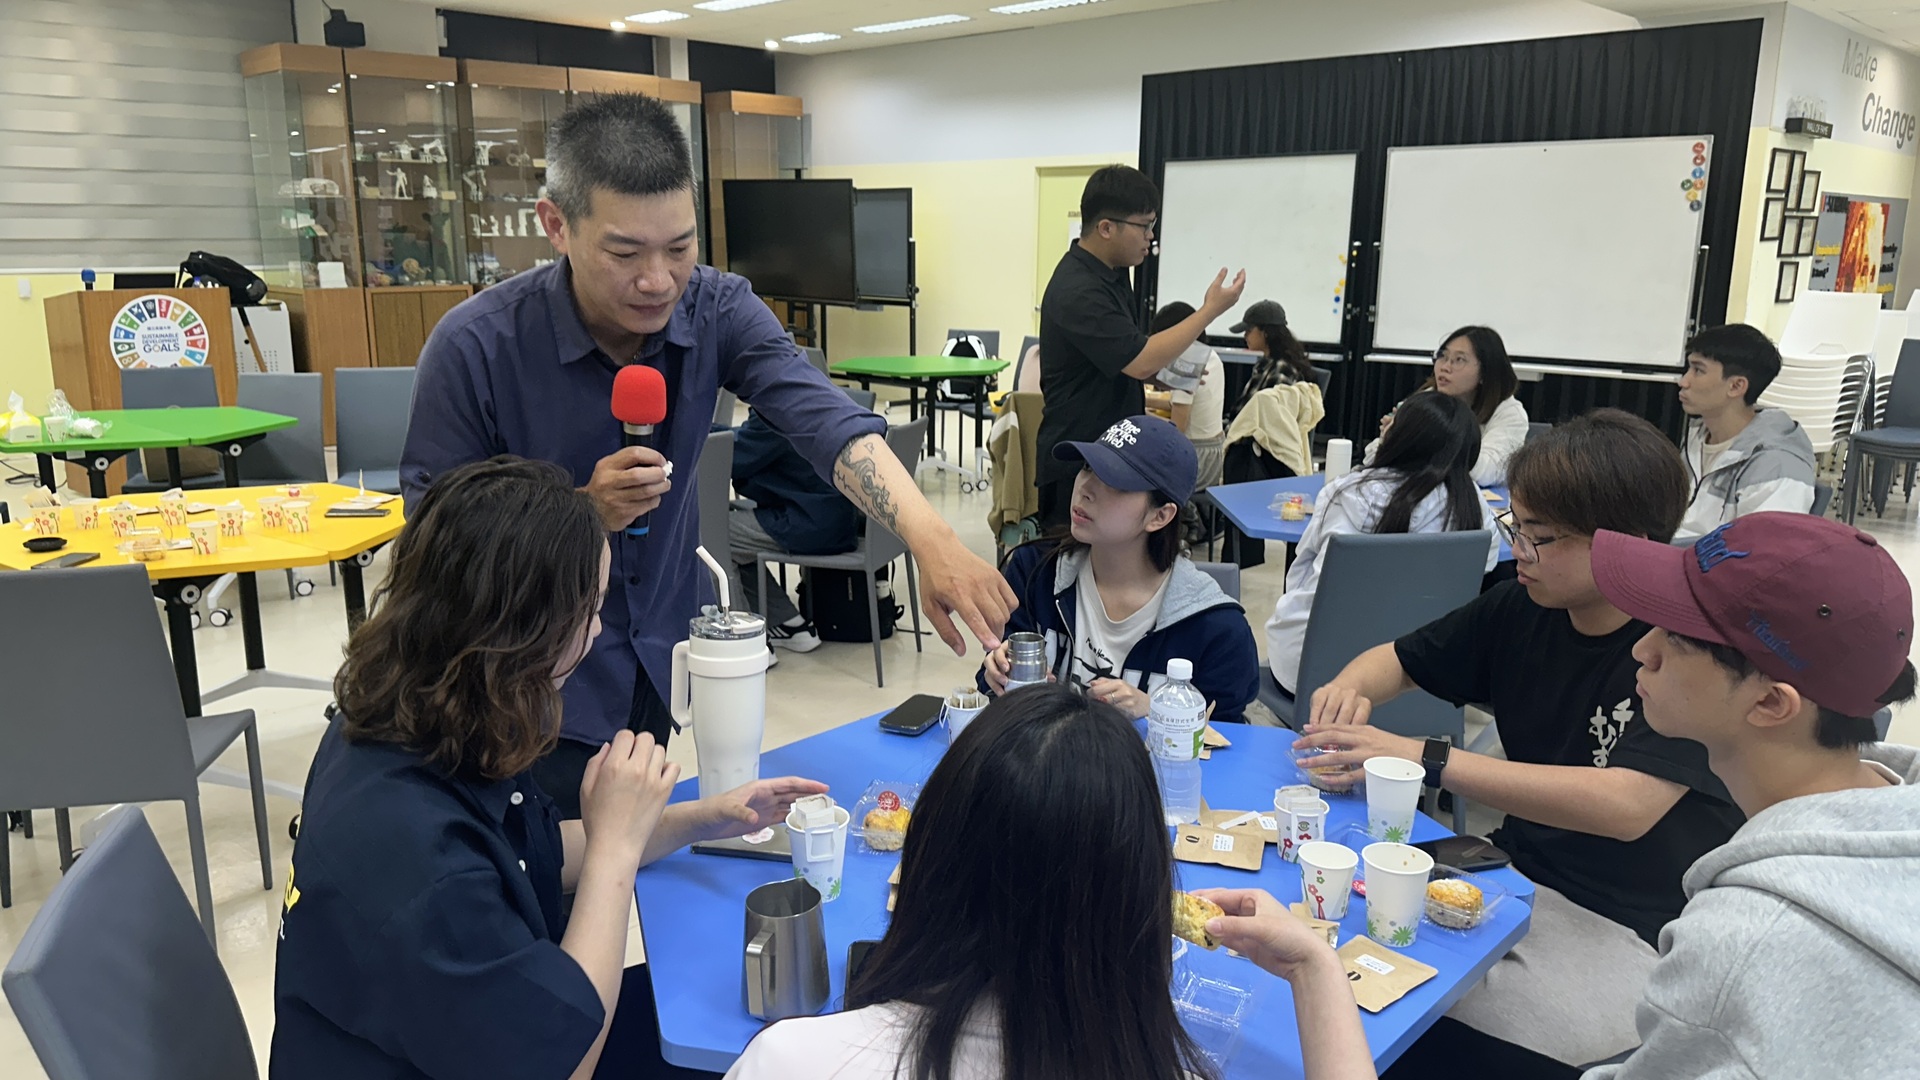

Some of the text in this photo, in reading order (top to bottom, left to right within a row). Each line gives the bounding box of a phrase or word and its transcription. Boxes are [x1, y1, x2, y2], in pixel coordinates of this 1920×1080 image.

[1841, 38, 1878, 83] Make
[1861, 92, 1916, 149] Change
[143, 343, 180, 353] GOALS
[1106, 424, 1137, 445] Service
[1119, 418, 1141, 435] Type
